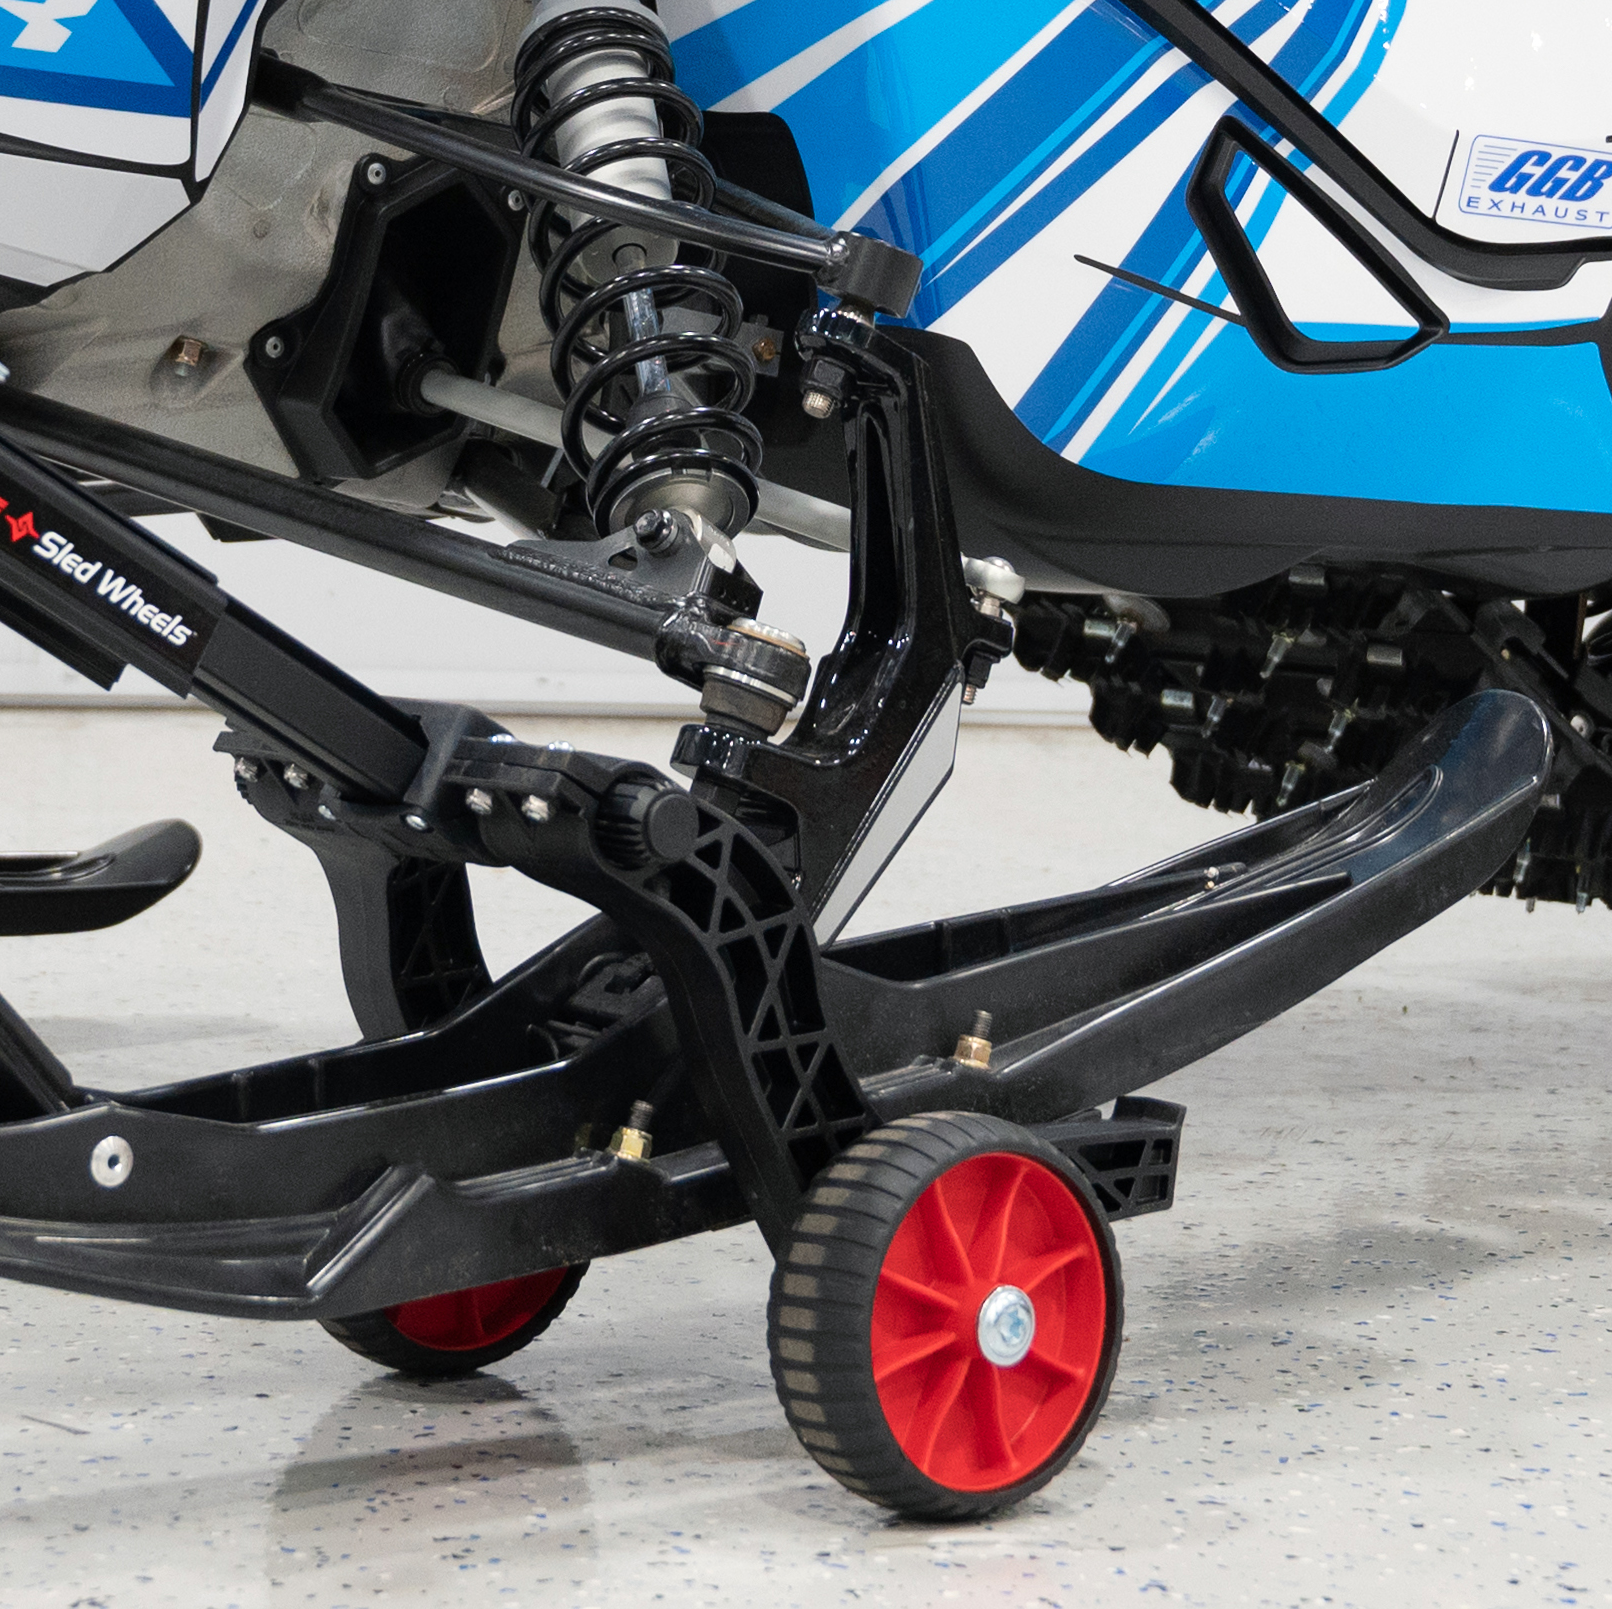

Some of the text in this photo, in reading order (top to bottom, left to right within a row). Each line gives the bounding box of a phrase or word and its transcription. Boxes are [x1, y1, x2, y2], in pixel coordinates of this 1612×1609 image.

[1465, 195, 1611, 223] EXHAUST
[32, 530, 193, 646] Sled Wheels
